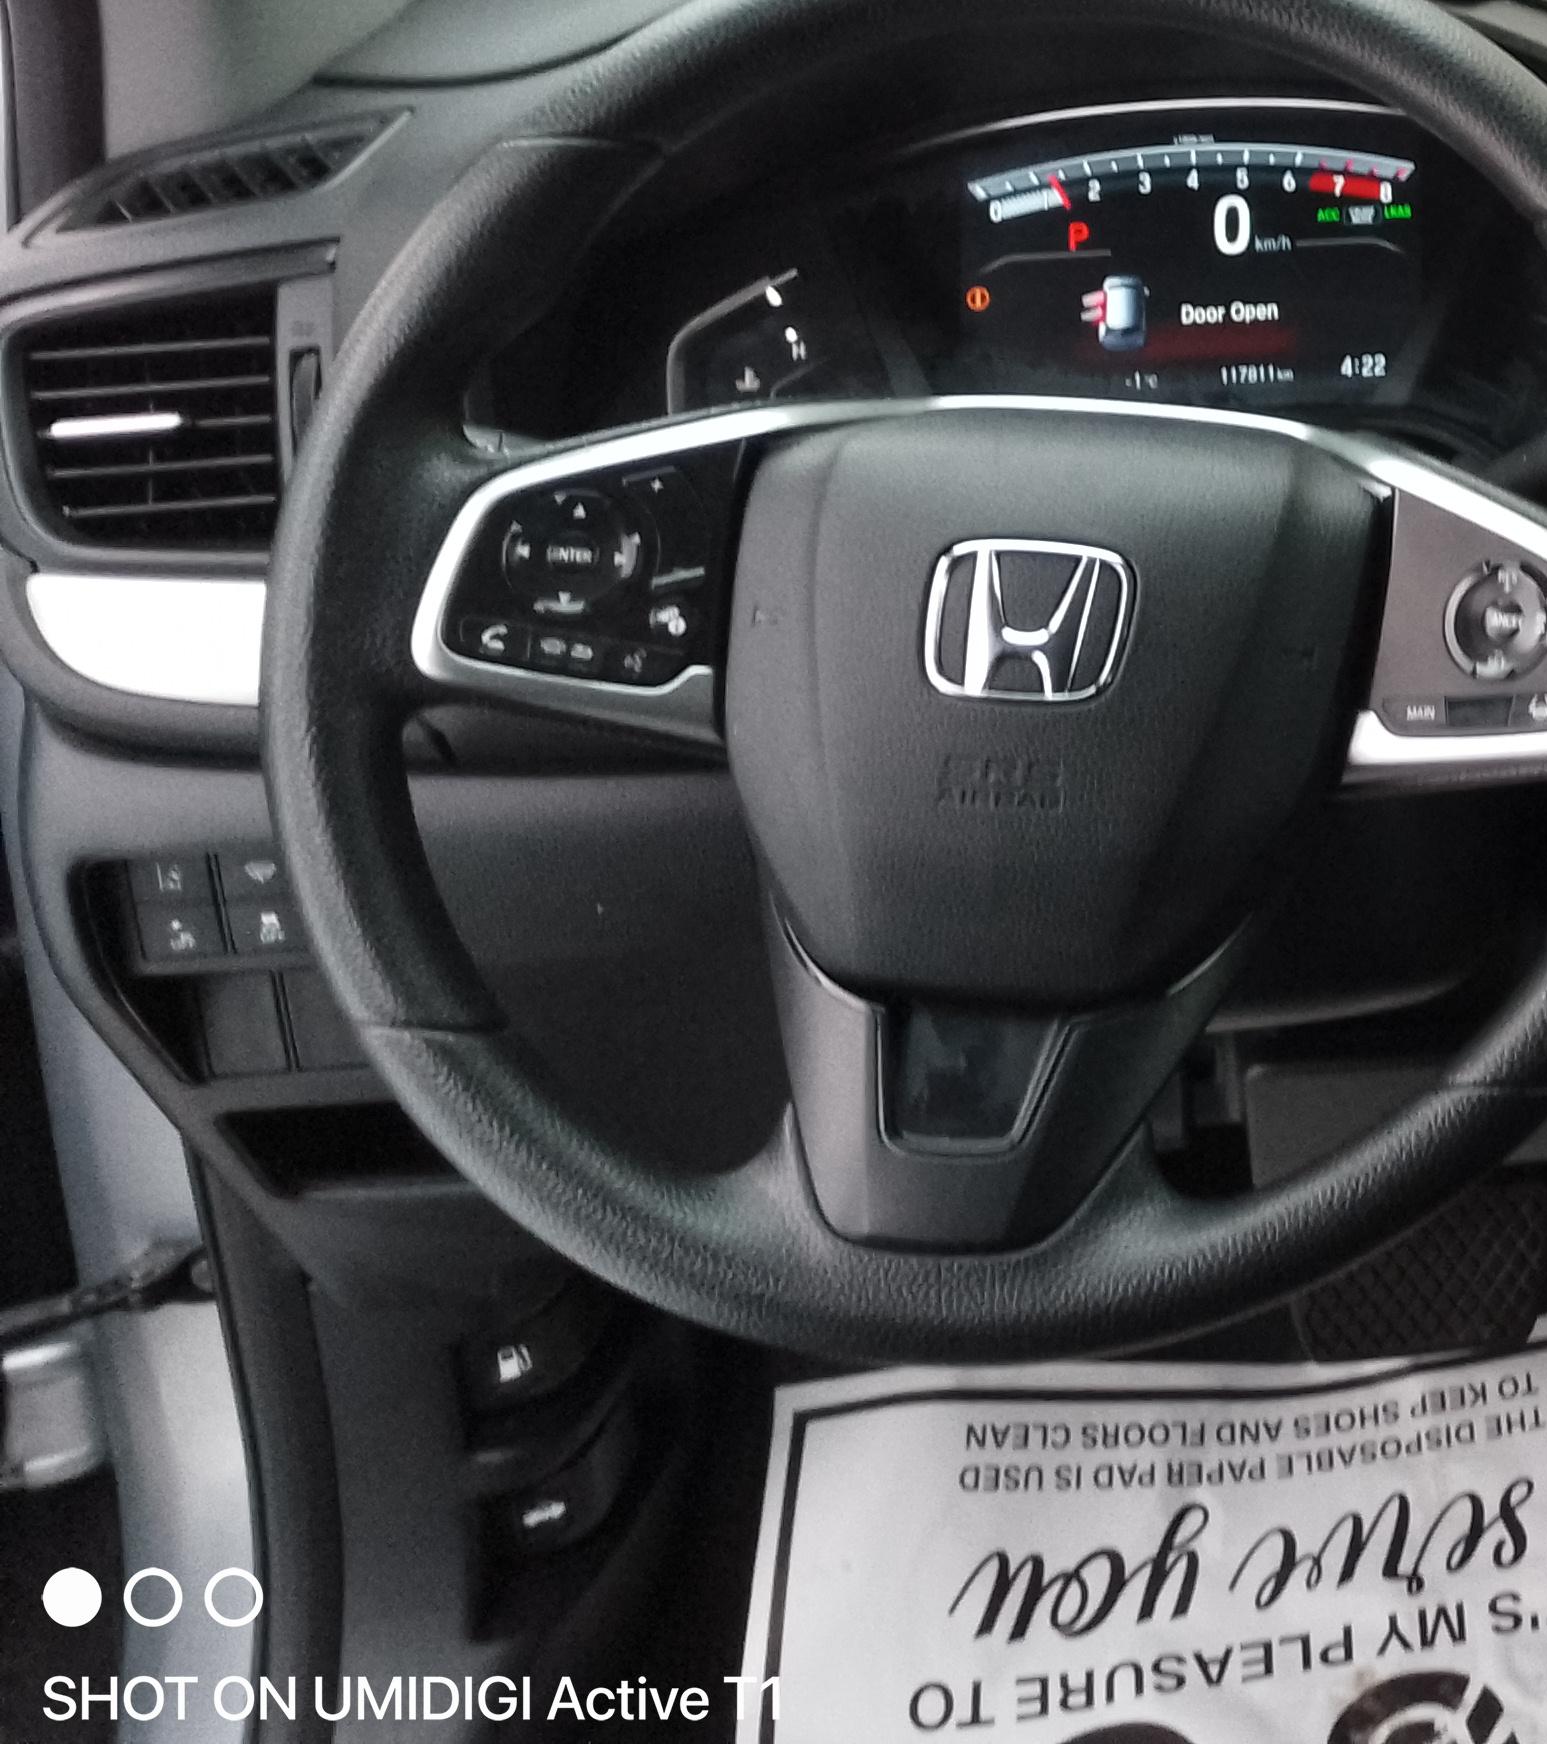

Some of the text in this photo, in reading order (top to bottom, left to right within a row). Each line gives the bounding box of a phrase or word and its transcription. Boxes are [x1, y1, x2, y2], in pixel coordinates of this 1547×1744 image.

[1087, 178, 1101, 202] 2
[1137, 171, 1151, 194] 3
[1186, 168, 1199, 191] 4
[1235, 167, 1249, 190] 5
[1281, 170, 1296, 193] 6
[1332, 174, 1345, 197] 7
[1068, 221, 1090, 252] P
[1213, 194, 1292, 256] 0 km/h
[1180, 301, 1280, 325] Door Open
[1341, 353, 1386, 378] 4:22
[1406, 704, 1436, 722] MAIN
[965, 1371, 1539, 1450] TO KEEP SHOES AND FLOORS CLEAN
[958, 1406, 1546, 1491] THE DISPOSABLE PAPER PAD IS USED
[948, 1477, 1534, 1645] serve you
[1376, 1601, 1468, 1656] MY
[1015, 1623, 1355, 1720] PLEASURE
[908, 1680, 997, 1732] TO
